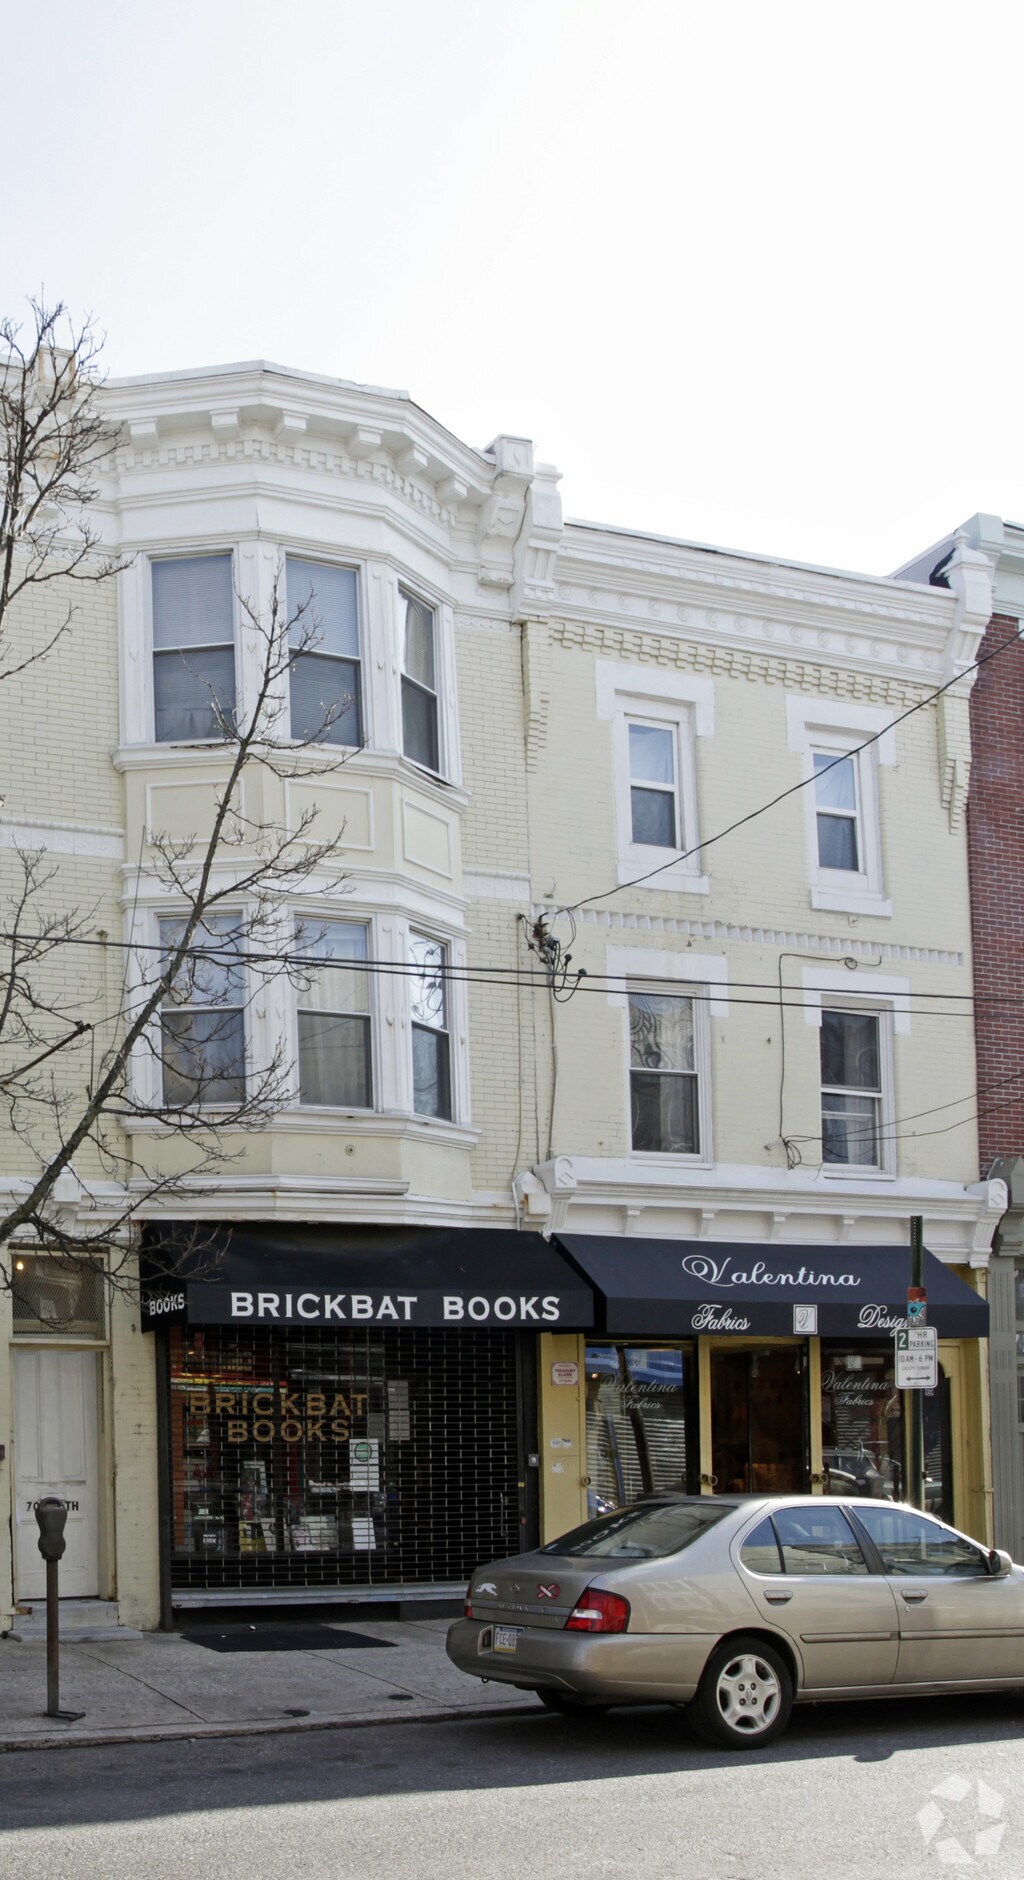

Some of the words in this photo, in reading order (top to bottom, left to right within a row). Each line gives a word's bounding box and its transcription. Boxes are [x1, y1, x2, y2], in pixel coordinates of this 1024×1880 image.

[681, 1254, 861, 1288] Valentina
[149, 1292, 185, 1316] BOOKS
[230, 1291, 418, 1321] BRICKBAT
[442, 1295, 561, 1322] BOOKS
[691, 1303, 752, 1331] Fabrics
[898, 1332, 907, 1348] 2
[909, 1340, 934, 1348] PARKING
[917, 1331, 928, 1339] HR
[600, 1374, 679, 1394] Valentina
[821, 1370, 891, 1393] Valentina
[189, 1392, 369, 1417] BRICKBAT
[833, 1391, 875, 1407] Fabrics
[227, 1418, 352, 1443] BOOKS
